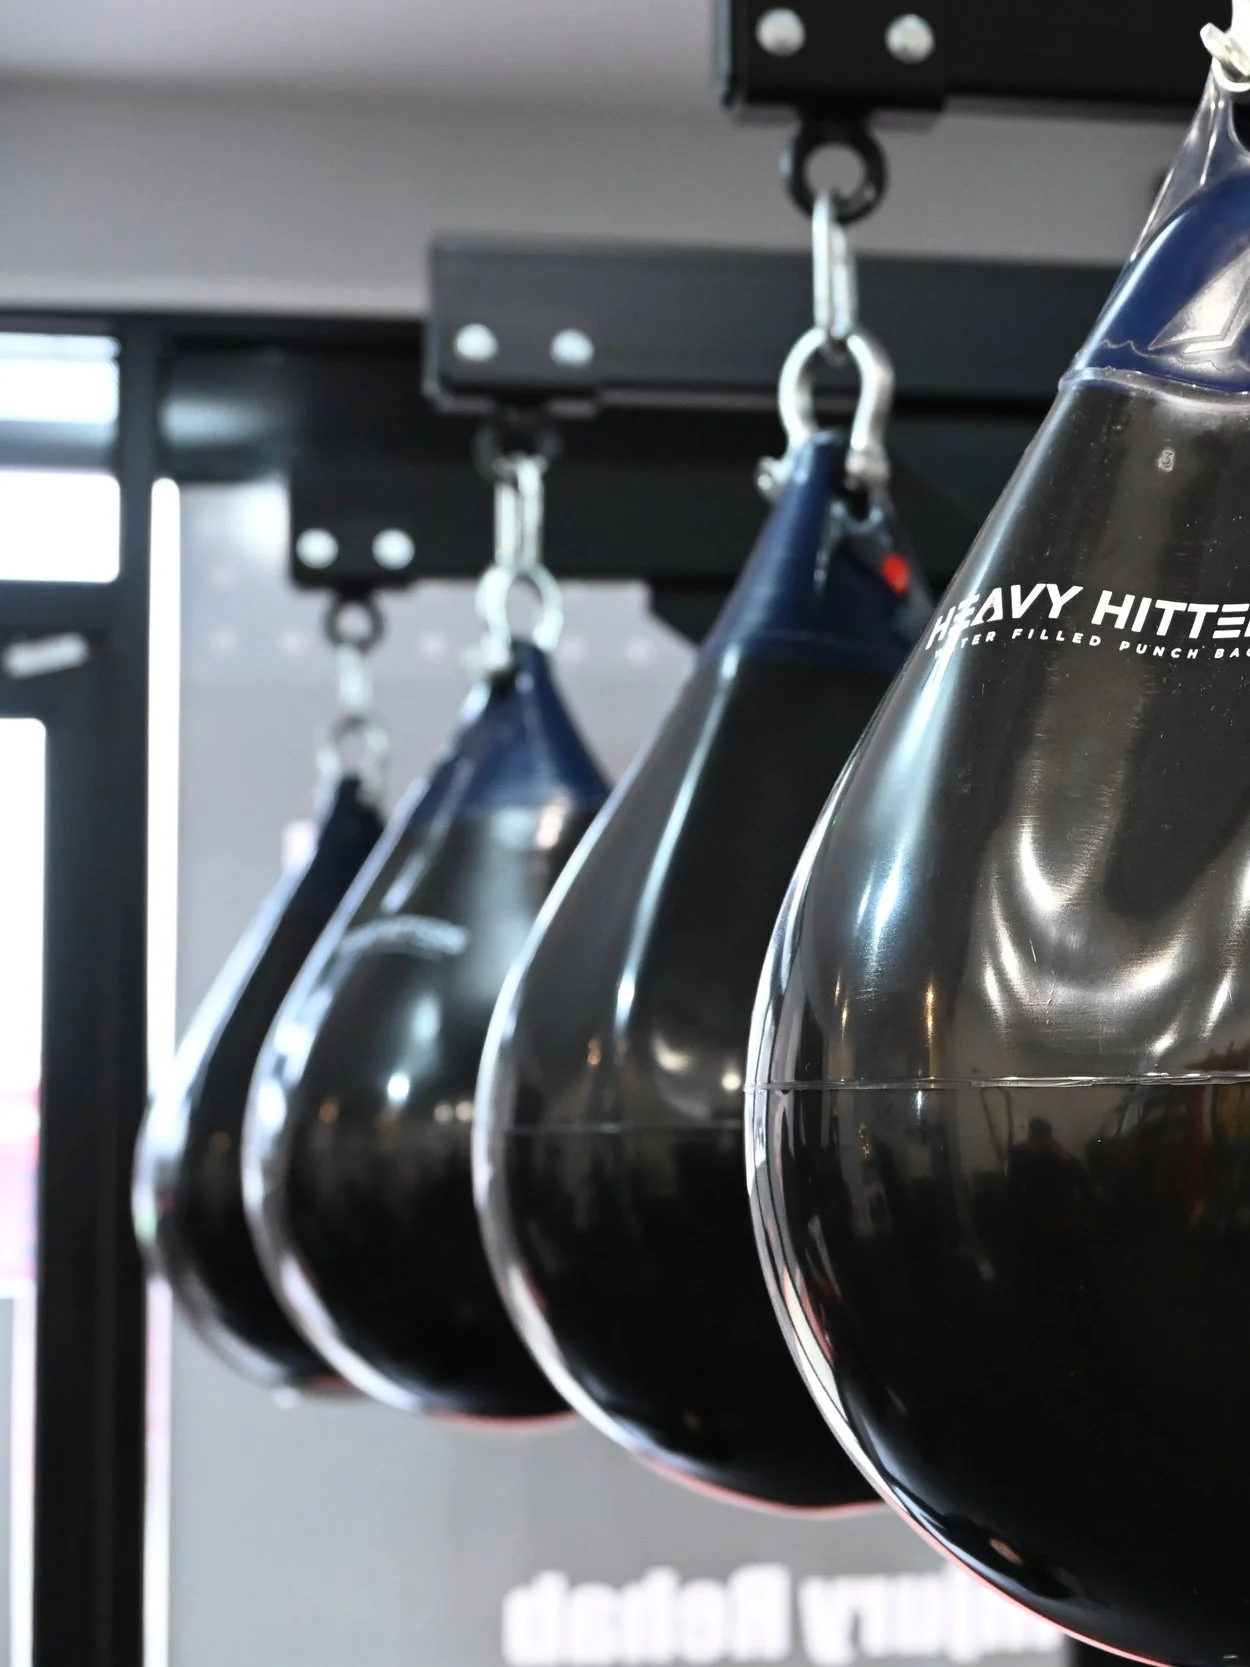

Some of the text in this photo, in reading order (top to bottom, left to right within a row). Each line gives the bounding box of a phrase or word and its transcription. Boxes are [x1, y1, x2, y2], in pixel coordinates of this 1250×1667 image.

[925, 583, 1084, 650] HEAVY
[934, 630, 997, 661] TER
[1011, 628, 1101, 647] FILLED
[1119, 640, 1199, 660] PUNCH
